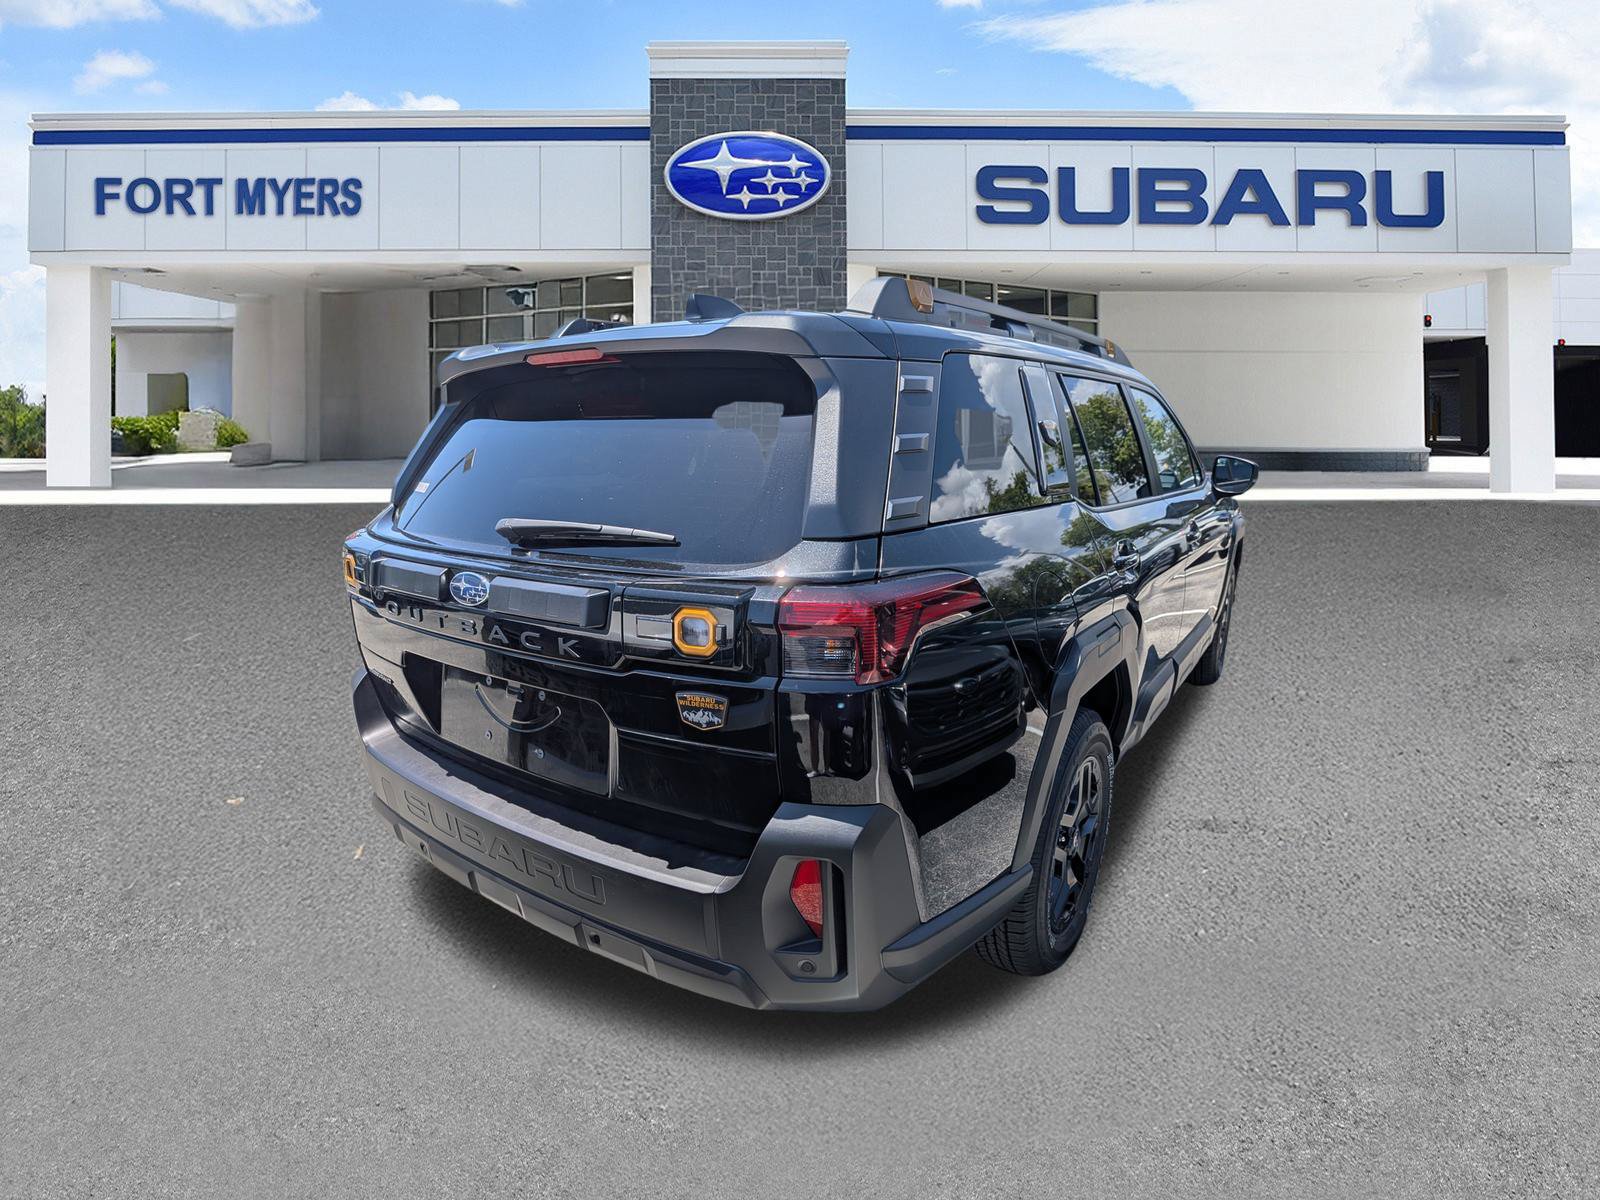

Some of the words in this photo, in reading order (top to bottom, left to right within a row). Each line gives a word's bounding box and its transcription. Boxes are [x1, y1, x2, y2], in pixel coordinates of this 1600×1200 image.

[94, 177, 223, 217] FORT
[235, 177, 363, 217] MYERS
[975, 165, 1446, 228] SUBARU
[385, 600, 581, 658] OUTBACK
[678, 699, 725, 710] WILDERNESS
[686, 695, 716, 704] SUBARU
[403, 789, 607, 905] SUBARU
